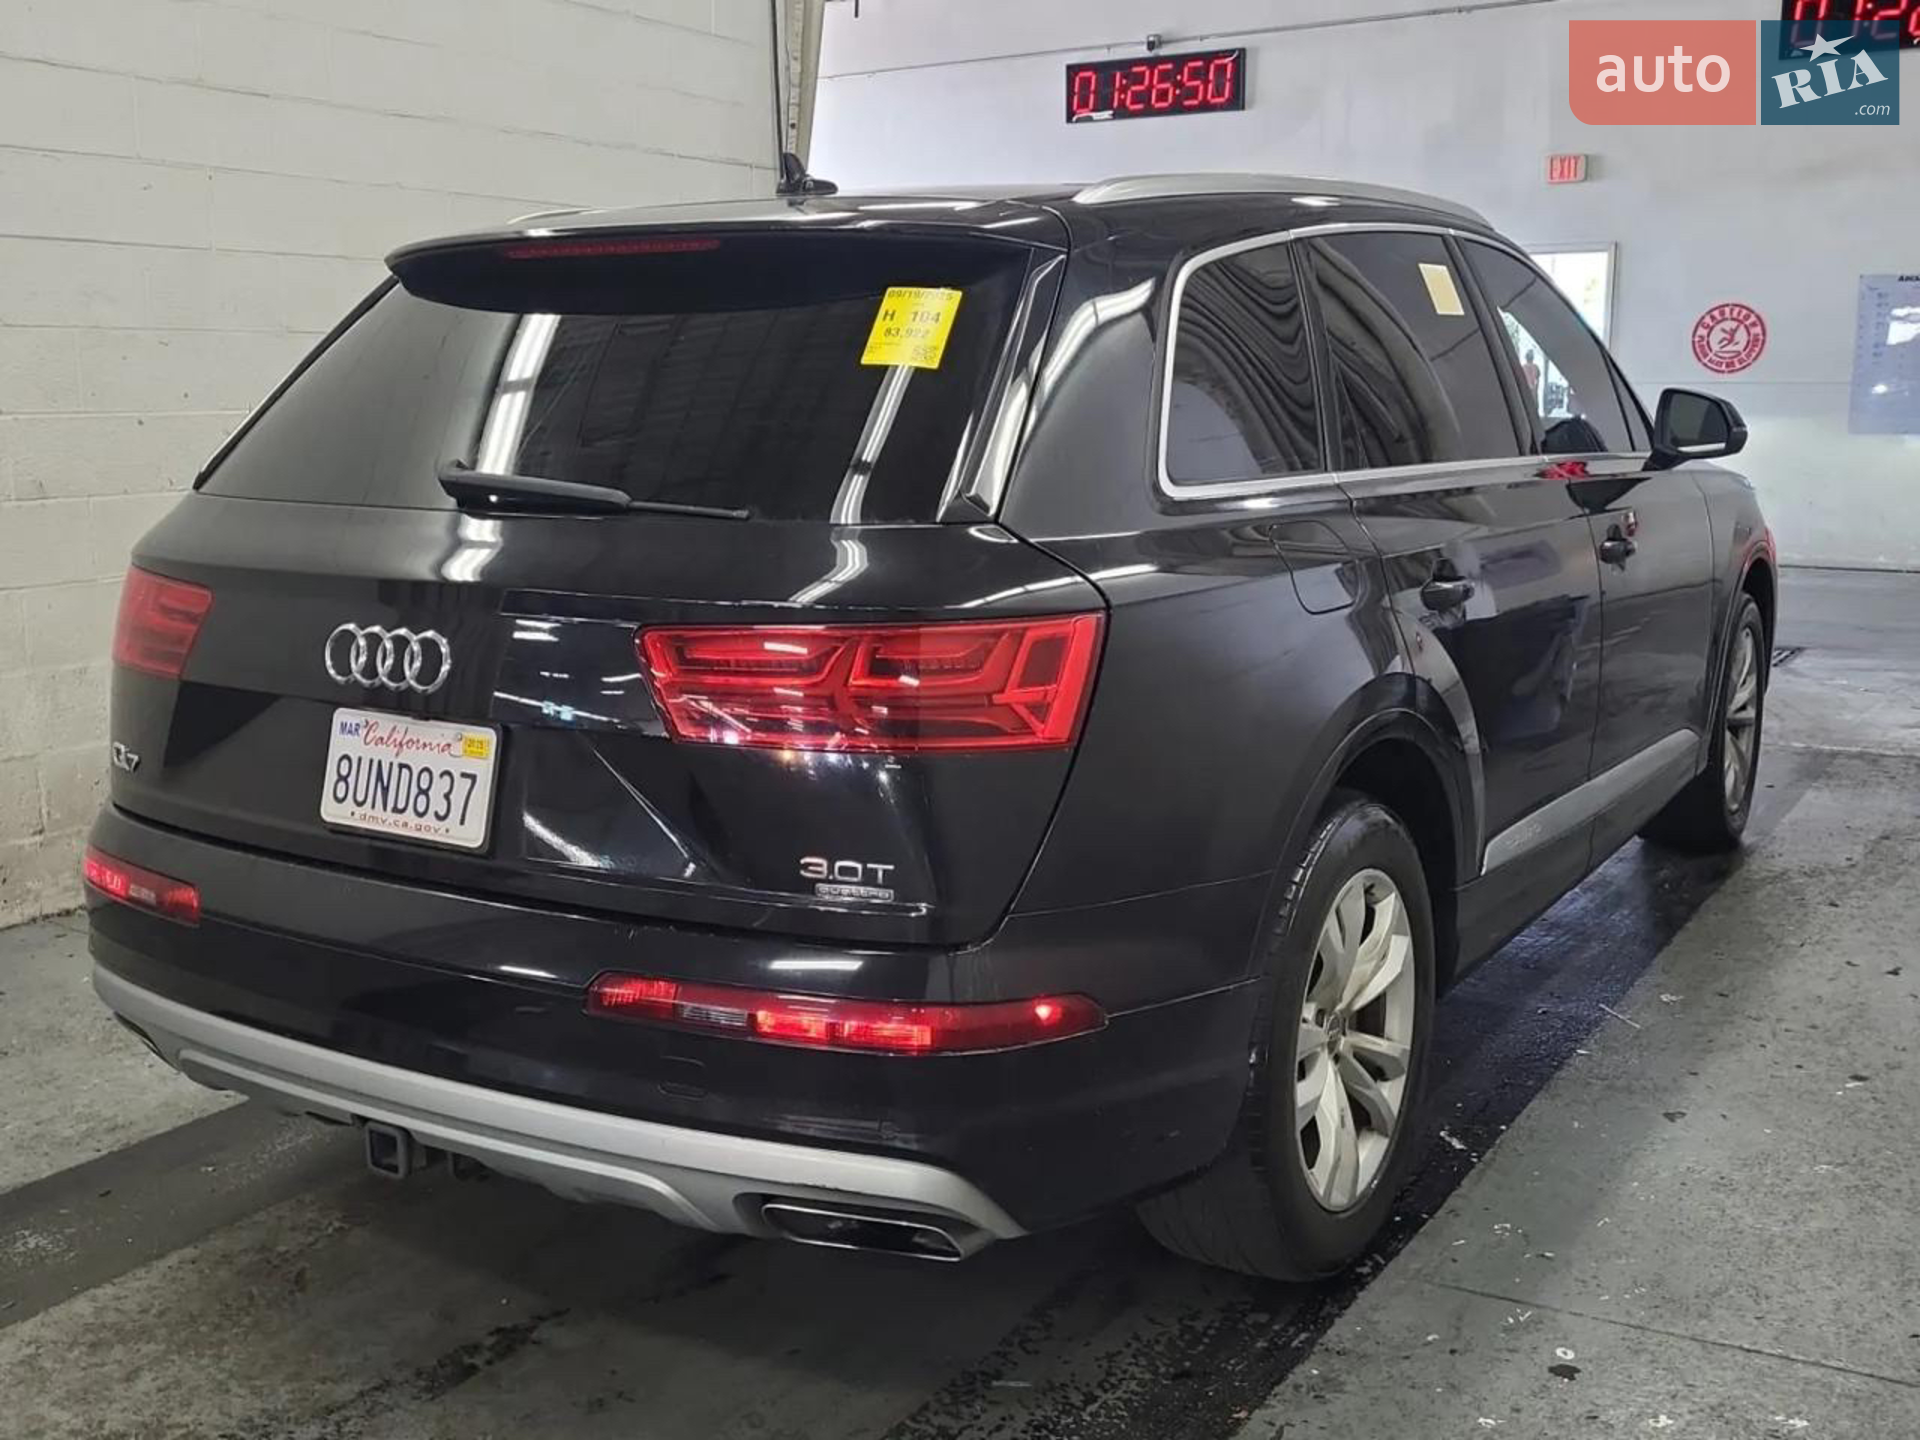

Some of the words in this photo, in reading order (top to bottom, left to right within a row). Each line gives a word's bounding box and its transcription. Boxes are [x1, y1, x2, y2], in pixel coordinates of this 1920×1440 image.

[1073, 58, 1233, 114] 01:26:50
[1550, 155, 1580, 180] EXIT
[882, 309, 895, 321] H
[1700, 306, 1759, 330] CAUTION
[339, 720, 361, 737] MAR
[362, 718, 459, 759] California
[332, 753, 478, 827] 8UND837
[359, 813, 442, 835] dmv.ca.gov
[800, 856, 895, 885] 3.0T
